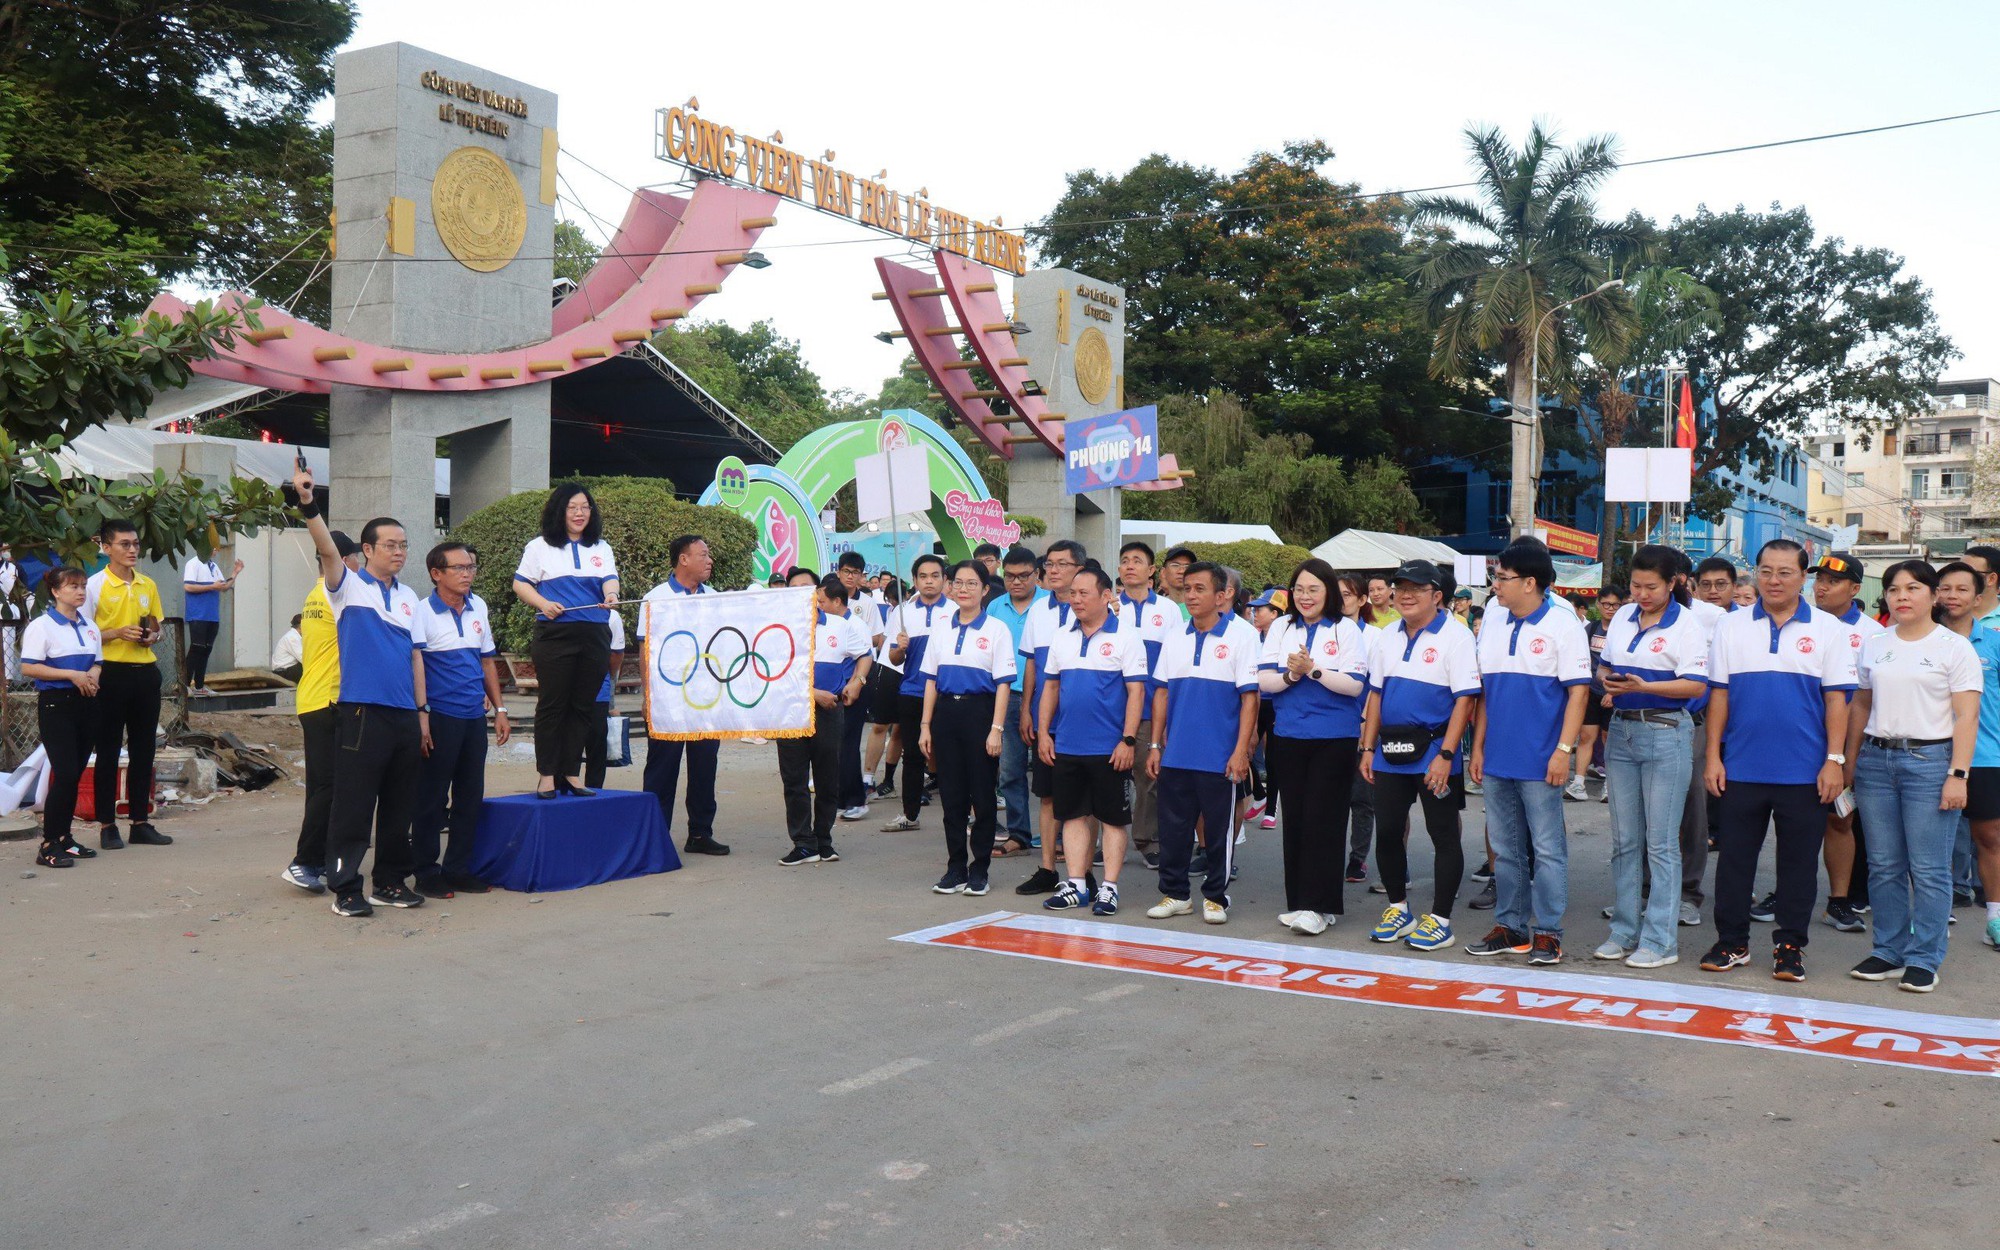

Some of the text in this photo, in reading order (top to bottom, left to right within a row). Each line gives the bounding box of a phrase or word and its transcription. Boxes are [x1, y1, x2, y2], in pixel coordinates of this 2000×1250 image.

[665, 95, 1028, 277] CÔNG VIÊN VĂN HÓA LÊ THỊ RIÊNG
[1069, 435, 1153, 470] PHƯỜNG 14
[947, 494, 973, 520] Sống
[1382, 742, 1415, 753] adidas
[1182, 956, 1380, 989] ĐÍCH
[1457, 988, 1700, 1024] PHÁT
